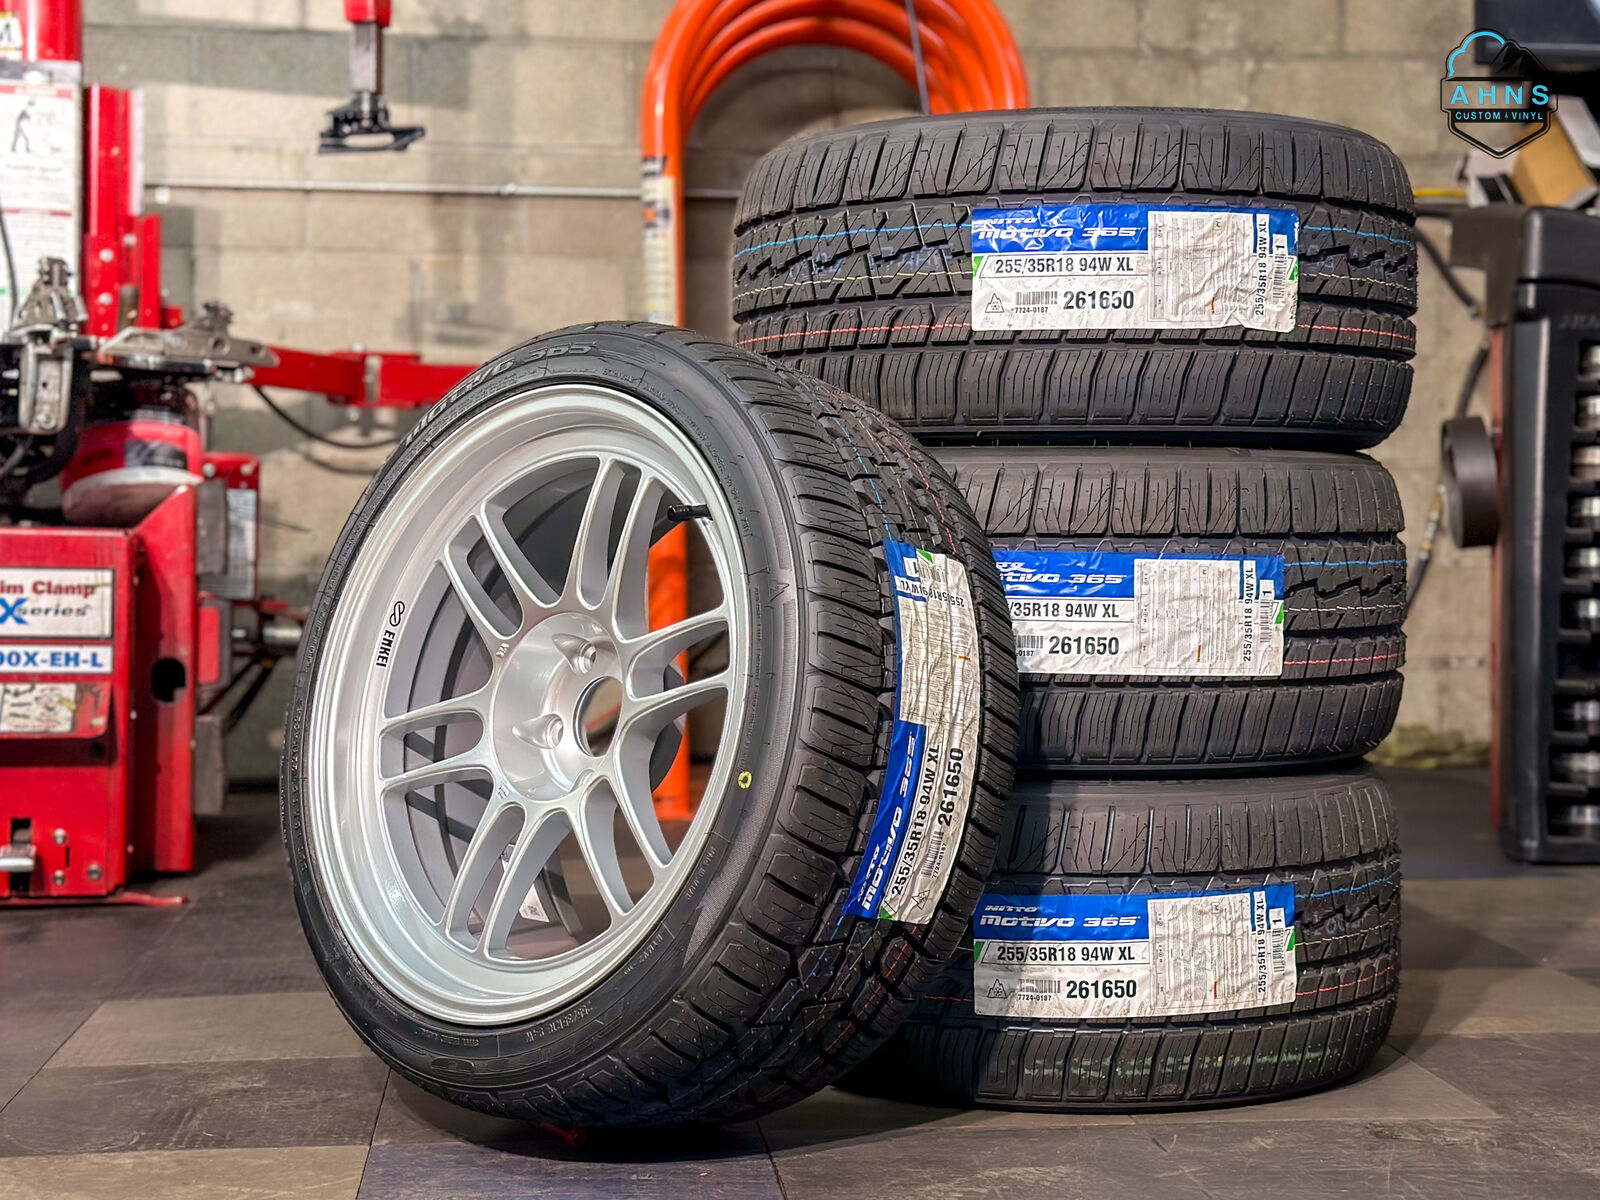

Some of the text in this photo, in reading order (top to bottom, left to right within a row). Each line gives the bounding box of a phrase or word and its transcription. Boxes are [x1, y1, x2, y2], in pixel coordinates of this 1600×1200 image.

[1082, 227, 1138, 238] 365
[995, 256, 1134, 275] 255/35R18 94W XL
[1255, 222, 1268, 316] 255/35R18 94W XL
[1063, 290, 1134, 310] 261650
[1000, 571, 1125, 584] tivo 365
[0, 580, 96, 598] im Clamp
[1008, 601, 1119, 618] /35R18 94W XL
[1243, 567, 1255, 662] 255/35R18 94W XL
[376, 630, 395, 667] ENKEI
[1049, 635, 1120, 655] 261650
[937, 748, 964, 828] 261650
[891, 743, 941, 896] 255/35R18 94W XL
[985, 904, 1038, 913] NITTO
[1083, 916, 1138, 927] 365
[997, 946, 1135, 962] 255/35R18 94W XL
[1256, 898, 1266, 993] 255/35R18 94W XL
[1066, 979, 1137, 999] 261650
